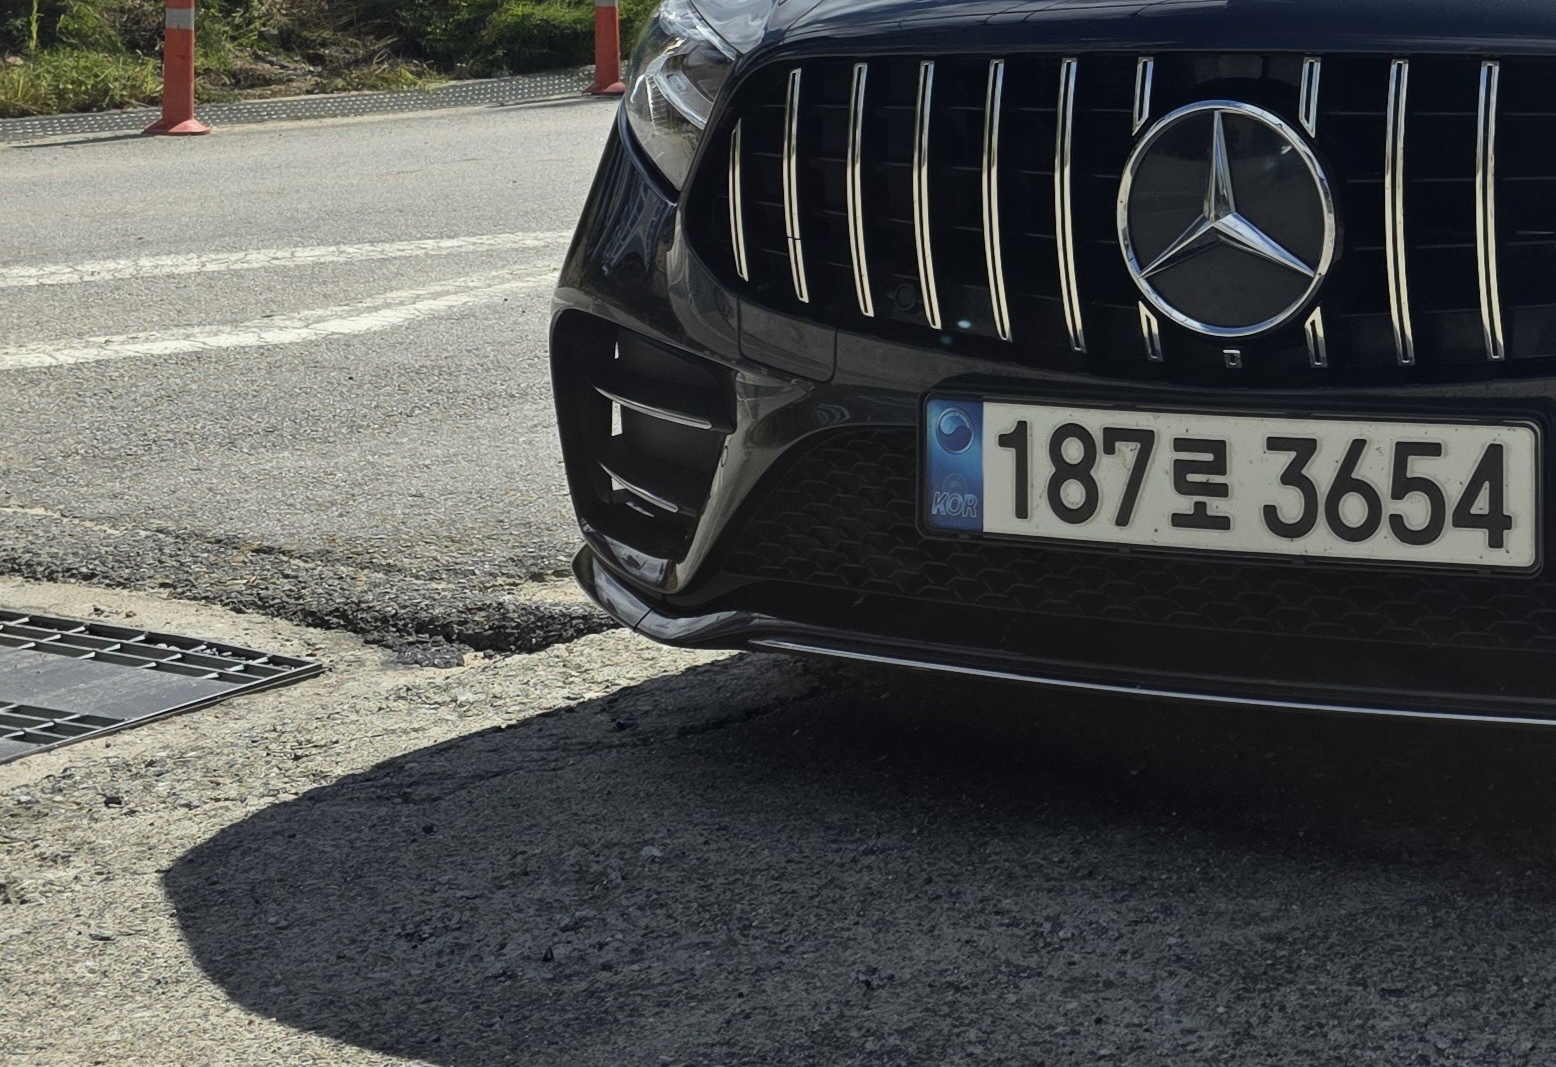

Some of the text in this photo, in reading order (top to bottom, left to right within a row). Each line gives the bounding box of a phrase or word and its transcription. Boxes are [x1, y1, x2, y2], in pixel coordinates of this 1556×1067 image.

[931, 491, 977, 518] KOR
[998, 420, 1513, 550] 187로 3654
